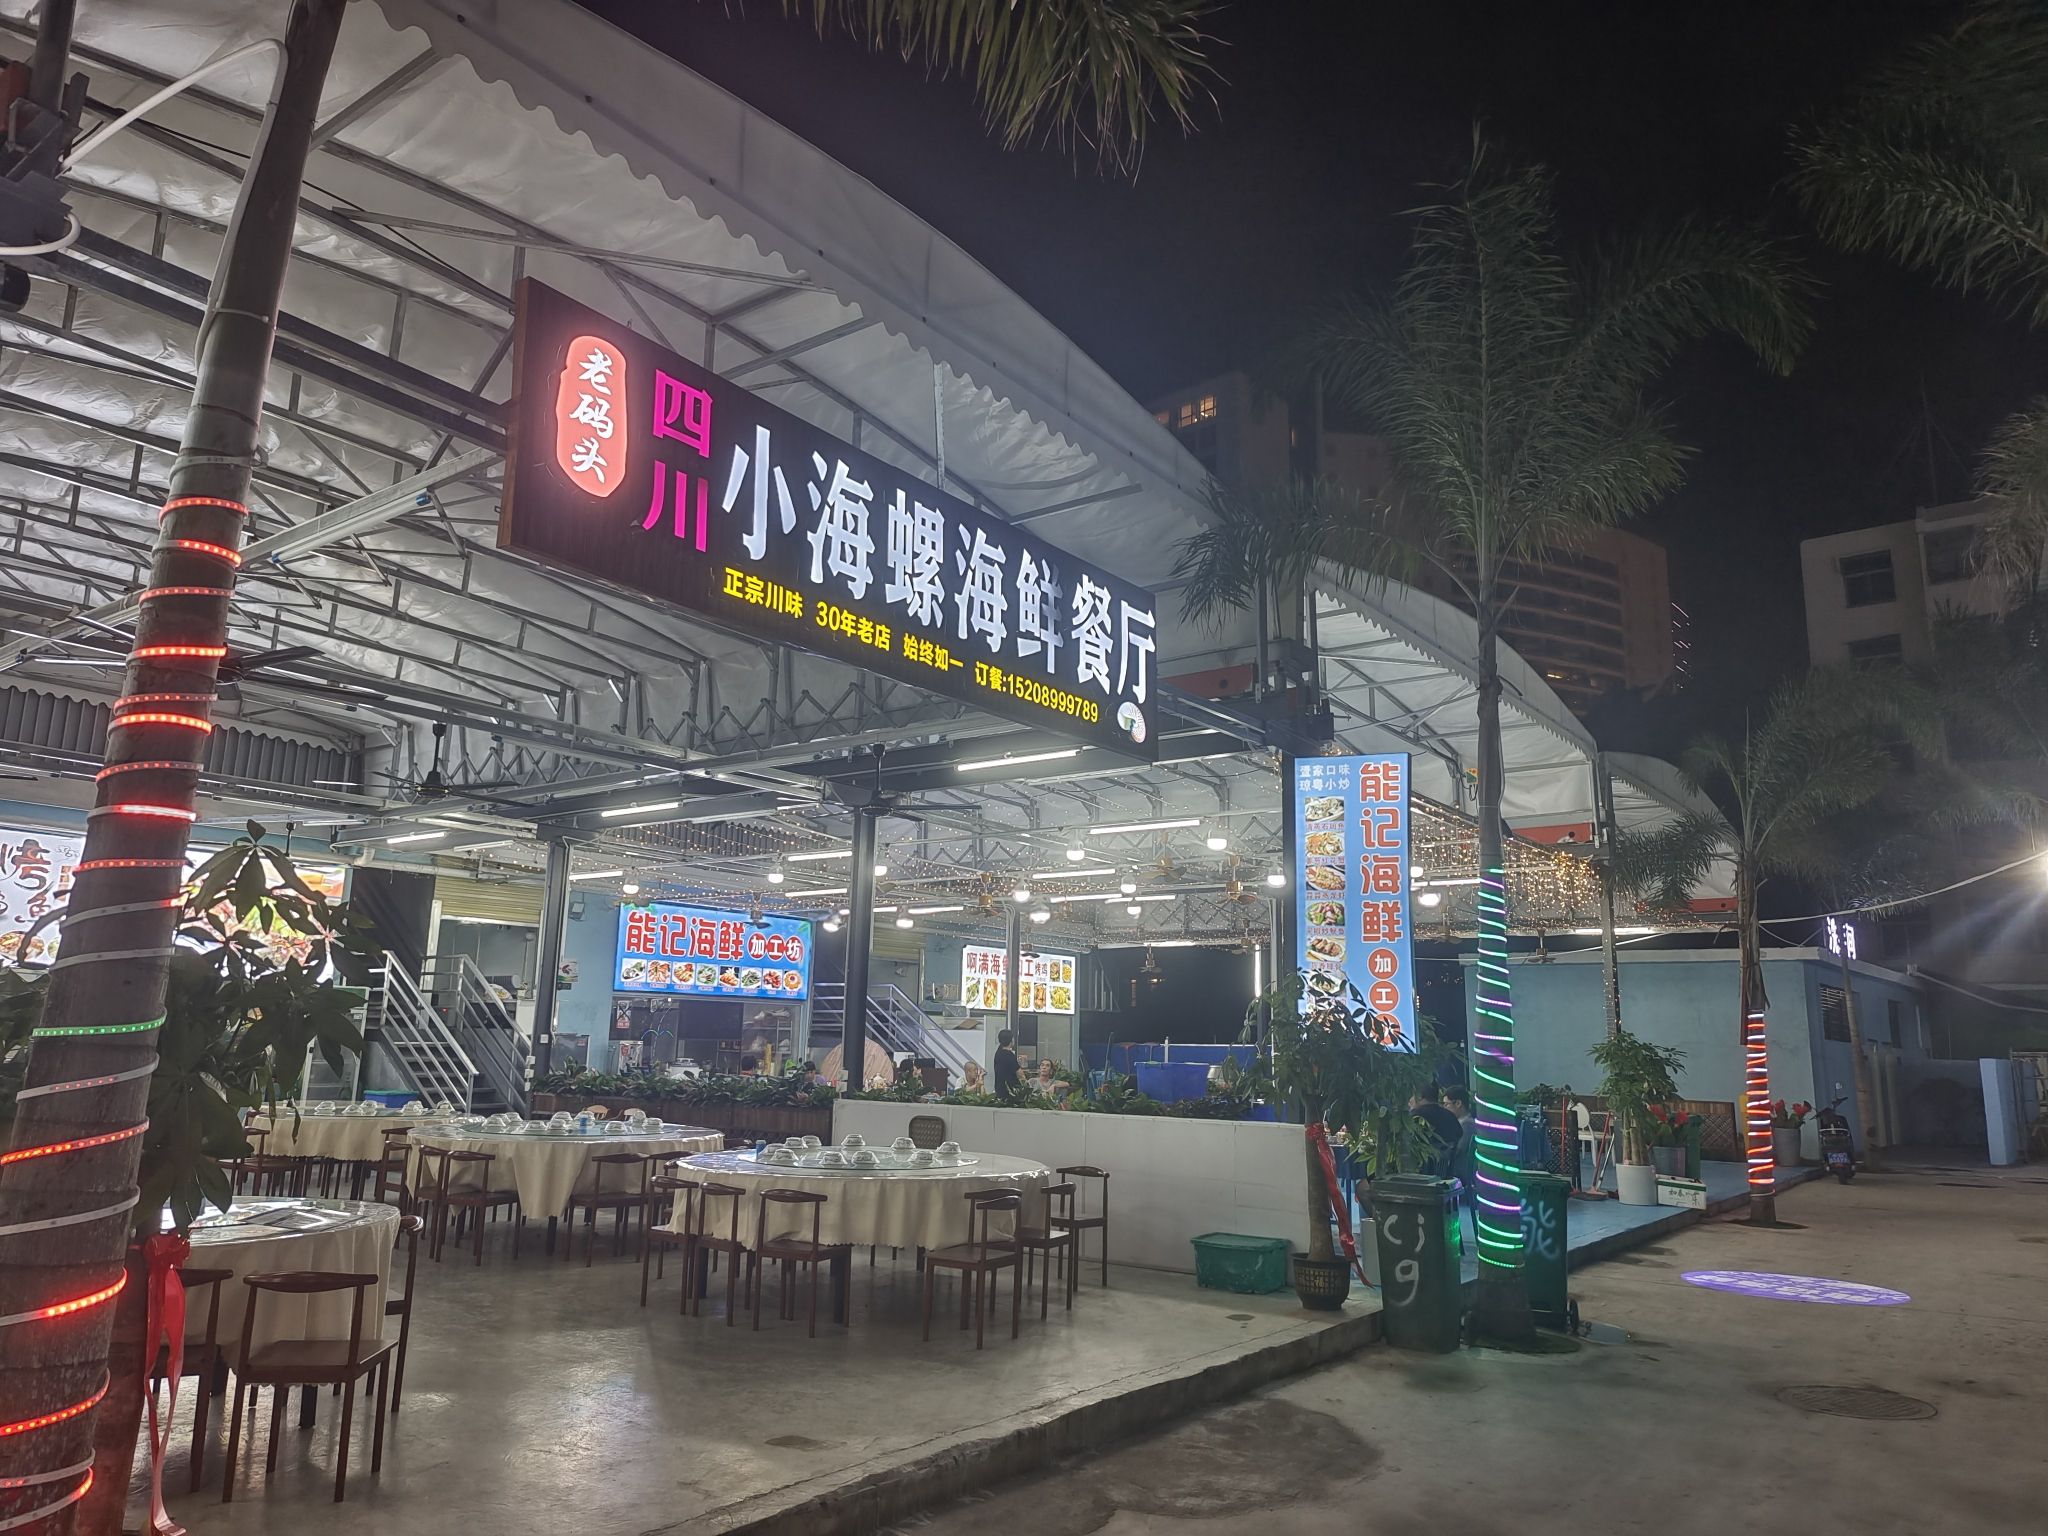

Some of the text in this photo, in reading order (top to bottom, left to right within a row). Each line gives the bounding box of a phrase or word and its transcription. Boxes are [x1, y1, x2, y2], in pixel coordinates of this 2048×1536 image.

[569, 347, 614, 484] 老码头
[642, 368, 714, 553] 四川
[721, 424, 1157, 704] 小海螺海鲜餐厅
[723, 566, 803, 619] 正宗川味
[816, 601, 891, 652] 30年老店
[903, 636, 964, 674] 始终如一
[1359, 761, 1404, 944] 能记海鲜
[625, 910, 802, 962] 能记海鲜 加工坊
[966, 952, 1034, 977] 啊满海工
